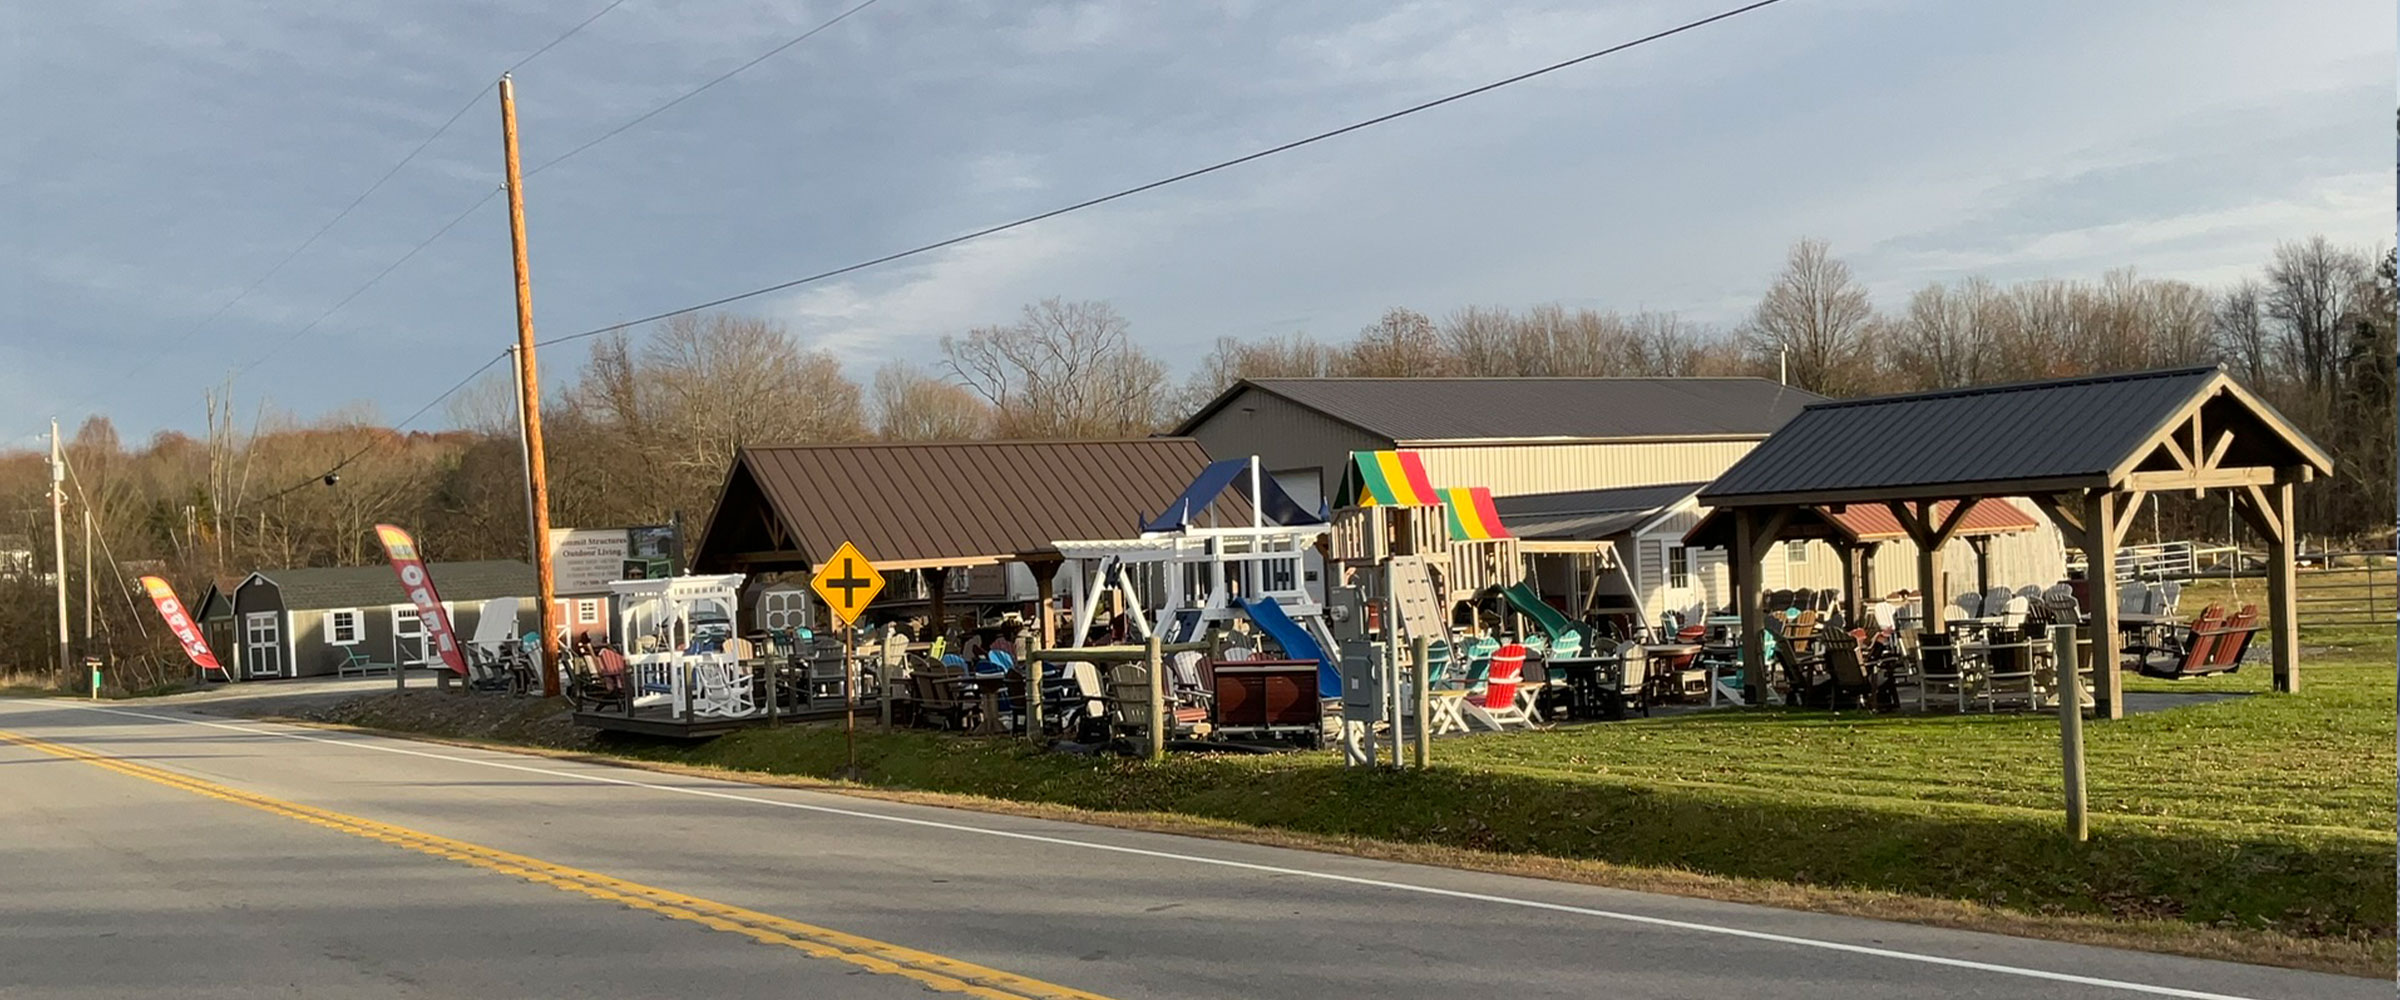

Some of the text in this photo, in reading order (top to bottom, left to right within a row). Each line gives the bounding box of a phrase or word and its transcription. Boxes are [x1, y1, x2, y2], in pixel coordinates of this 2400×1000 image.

[557, 537, 627, 546] ummit Structures
[562, 548, 597, 557] Outdoor
